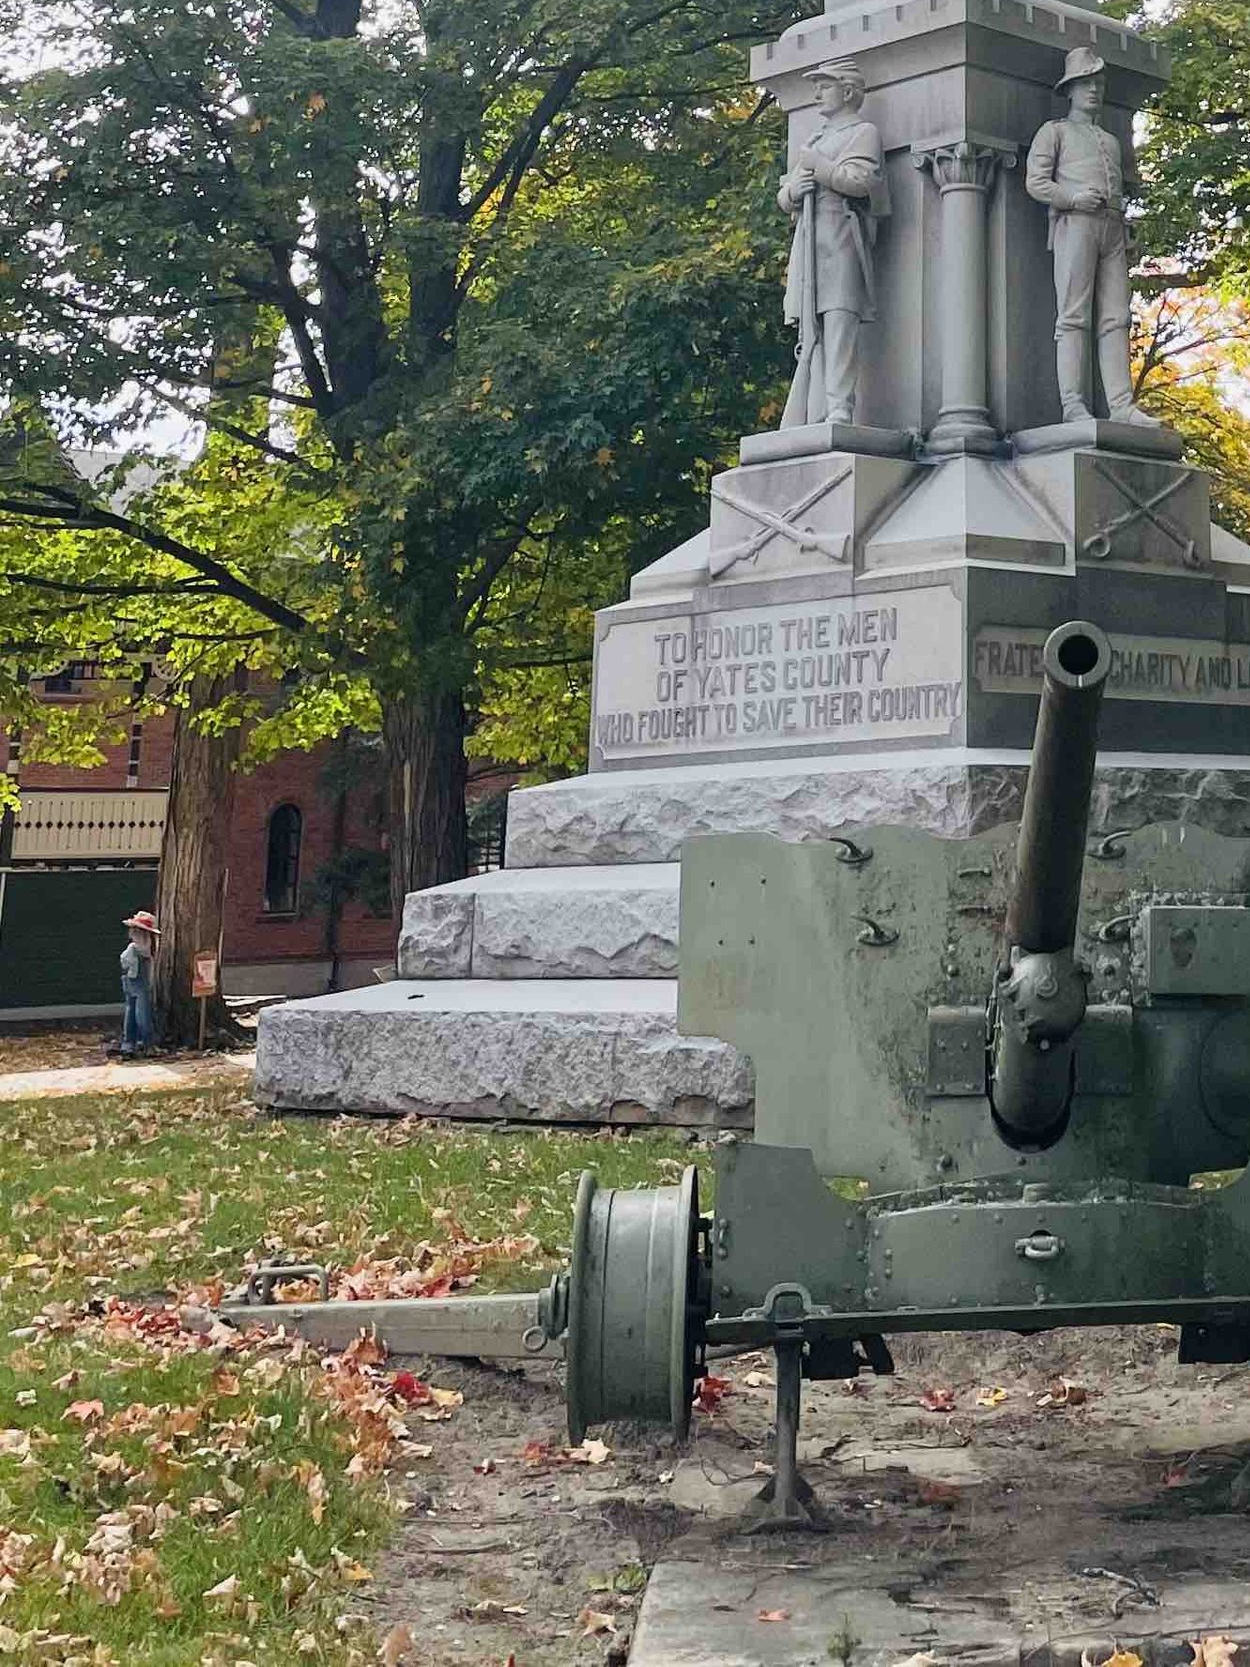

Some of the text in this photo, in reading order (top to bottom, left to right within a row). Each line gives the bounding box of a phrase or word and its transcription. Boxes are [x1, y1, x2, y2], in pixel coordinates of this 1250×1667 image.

[655, 607, 898, 666] TO HONOR THE MEN
[656, 648, 890, 702] OF YATES COUNTY
[1109, 649, 1191, 687] CHARITY
[1194, 655, 1231, 691] AND
[598, 681, 962, 745] WHO FOUGHT TO SAVE THEIR COUNTRY
